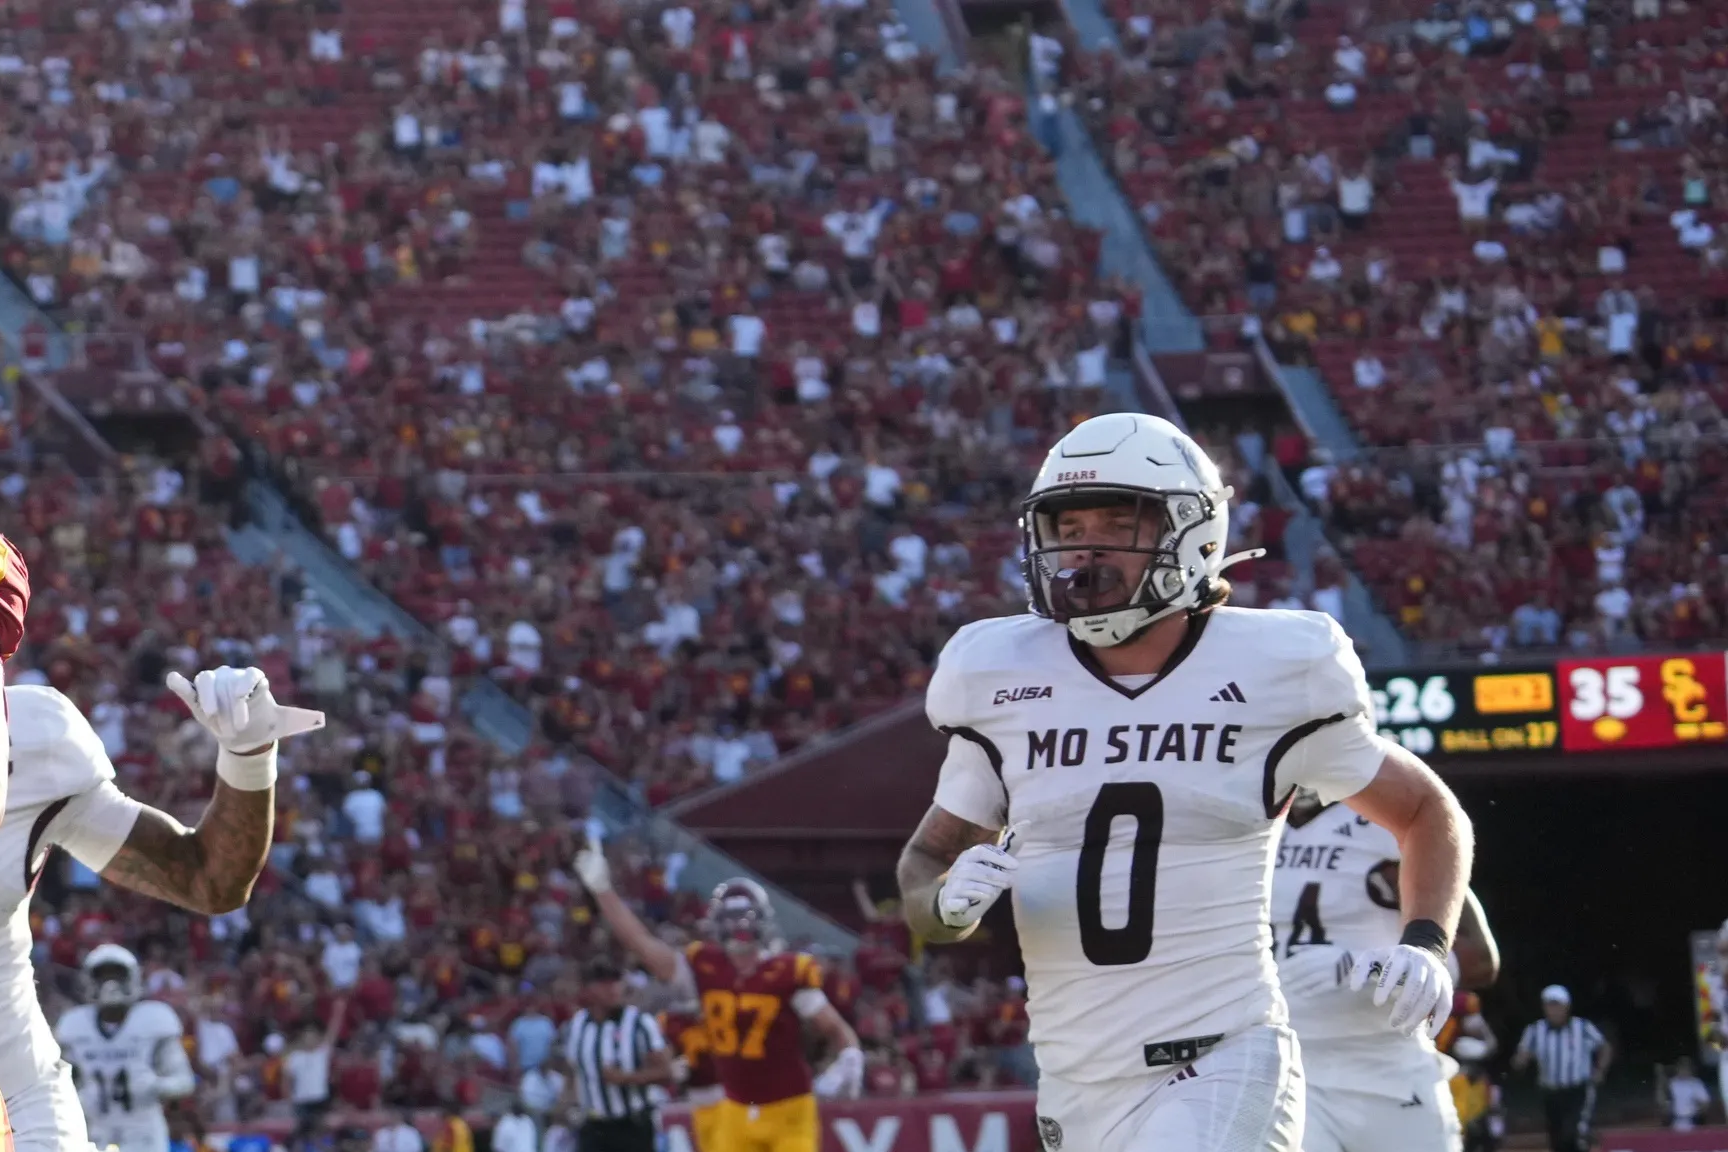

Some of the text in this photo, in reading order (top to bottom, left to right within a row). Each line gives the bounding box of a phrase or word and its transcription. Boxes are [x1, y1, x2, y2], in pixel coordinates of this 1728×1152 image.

[1057, 470, 1097, 482] BEARS
[1570, 666, 1643, 720] 35
[1026, 723, 1243, 770] MO STATE
[1076, 782, 1164, 965] 0
[702, 989, 781, 1059] 87
